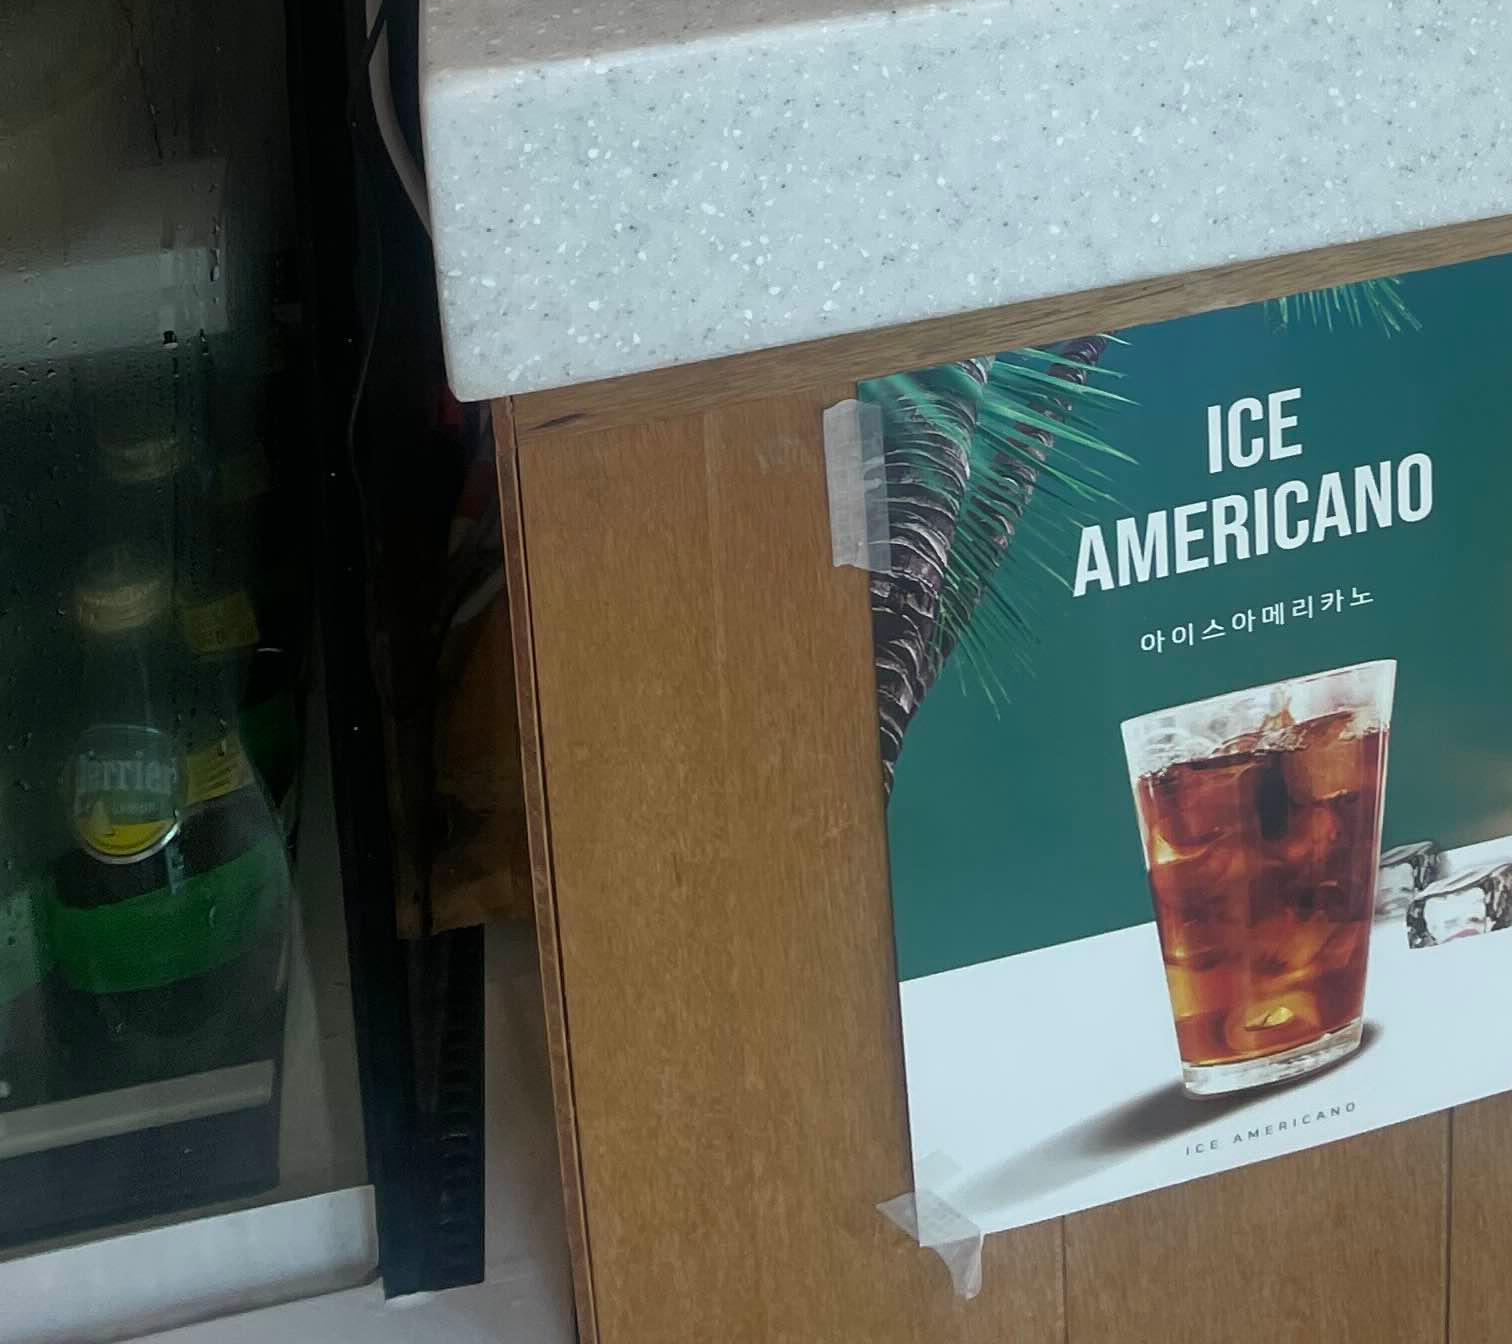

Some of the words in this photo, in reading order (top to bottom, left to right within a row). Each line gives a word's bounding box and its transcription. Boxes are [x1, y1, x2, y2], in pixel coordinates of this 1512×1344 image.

[1207, 387, 1303, 474] ICE
[1073, 452, 1433, 598] AMERICANO
[1140, 585, 1375, 655] 아이스아메리카노
[1186, 1139, 1219, 1156] ICE
[1233, 1102, 1357, 1144] AMERICANO
